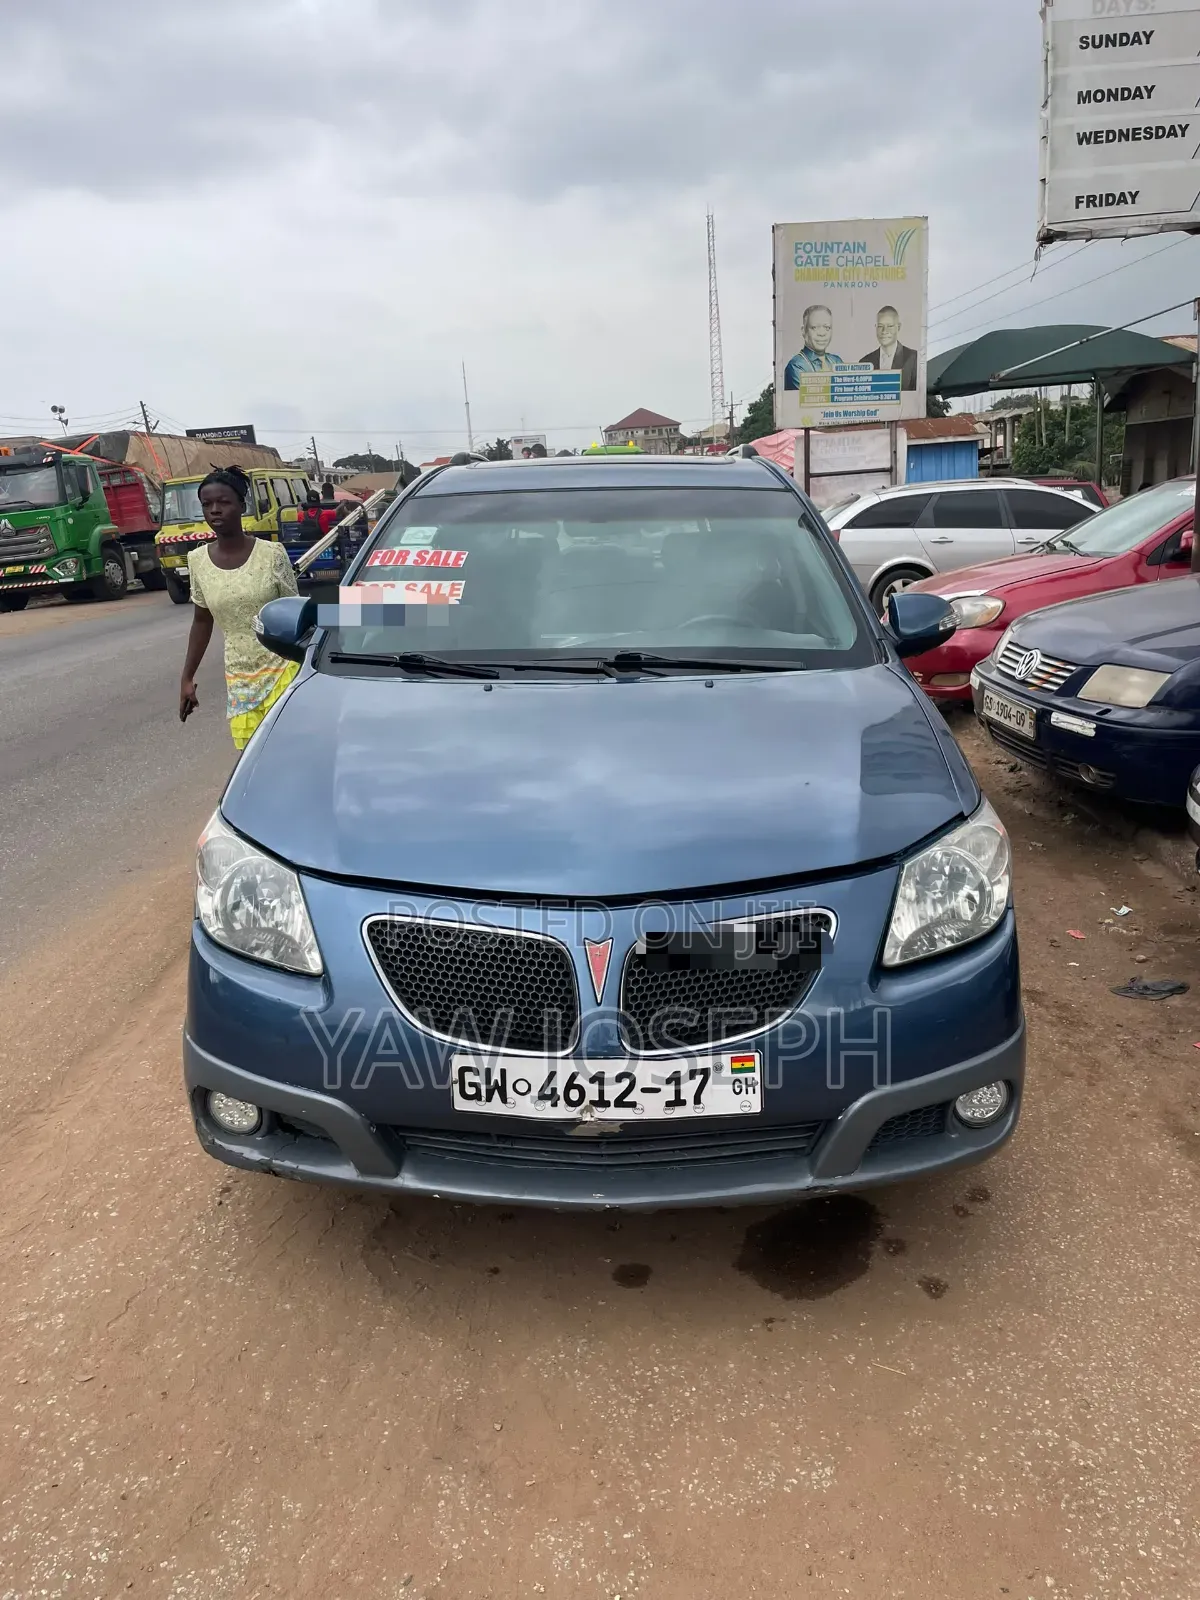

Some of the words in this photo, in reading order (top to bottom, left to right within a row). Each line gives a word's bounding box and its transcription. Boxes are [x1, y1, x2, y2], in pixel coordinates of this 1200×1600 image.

[1079, 30, 1155, 49] SUNDAY
[1077, 85, 1156, 104] MONDAY
[1076, 124, 1190, 145] WEDNESDAY
[1075, 191, 1140, 209] FRIDAY
[794, 241, 867, 254] FOUNTAIN
[794, 254, 830, 267] GATE
[836, 255, 889, 267] CHAPEL
[368, 550, 411, 566] FOR
[413, 551, 465, 567] SALE
[459, 1066, 507, 1104] GW
[537, 1067, 712, 1107] 4612-17
[732, 1078, 756, 1095] GH
